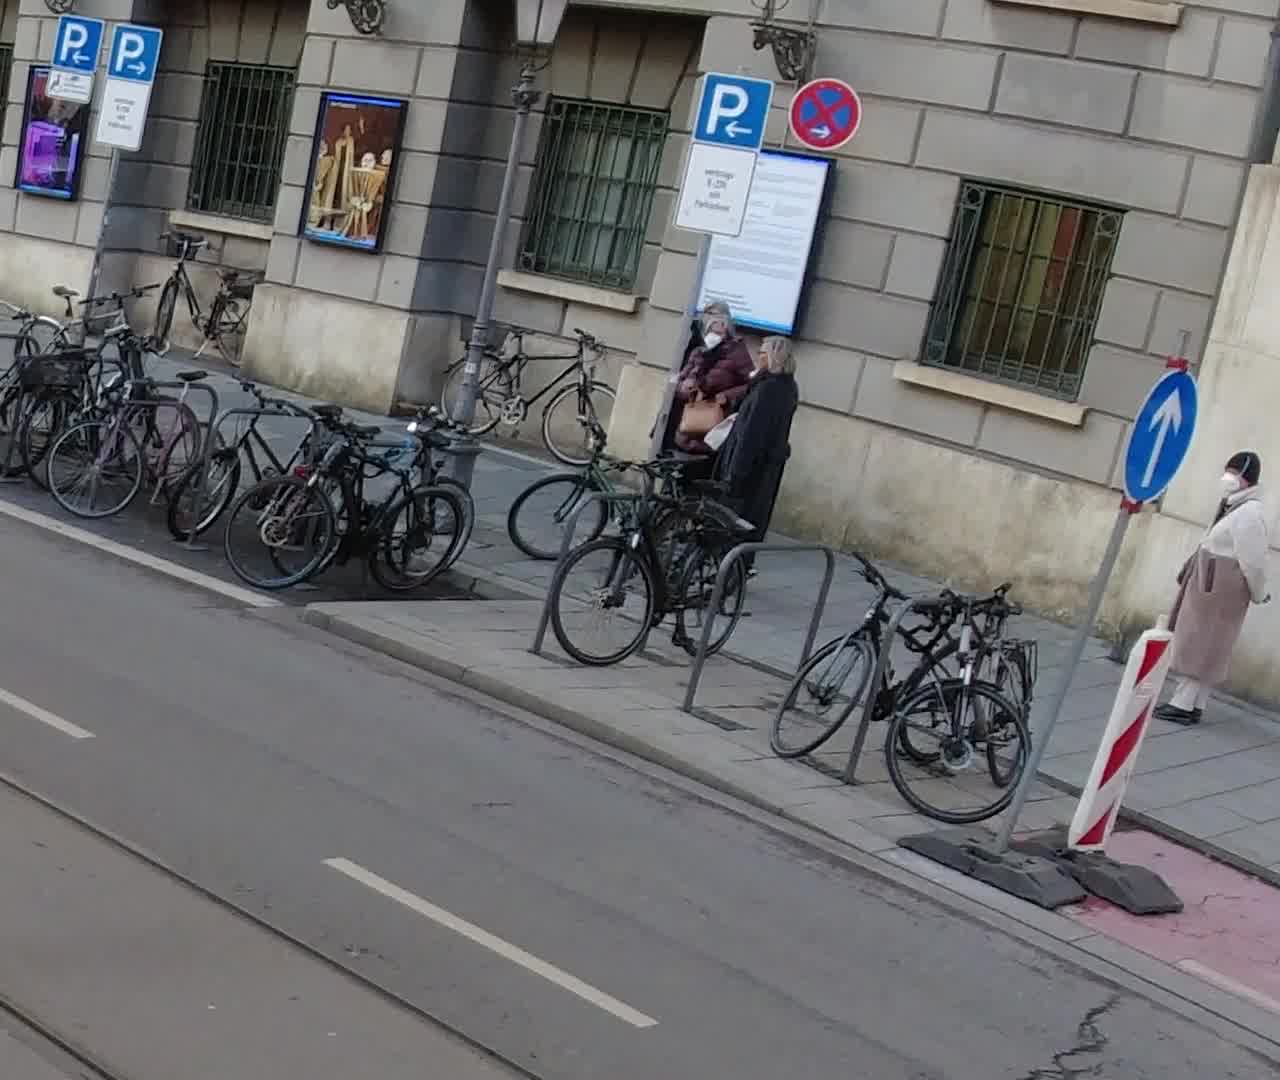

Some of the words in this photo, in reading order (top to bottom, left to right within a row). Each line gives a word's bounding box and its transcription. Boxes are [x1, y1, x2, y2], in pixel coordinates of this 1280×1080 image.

[60, 23, 89, 62] P
[115, 31, 145, 72] P
[706, 83, 749, 134] P
